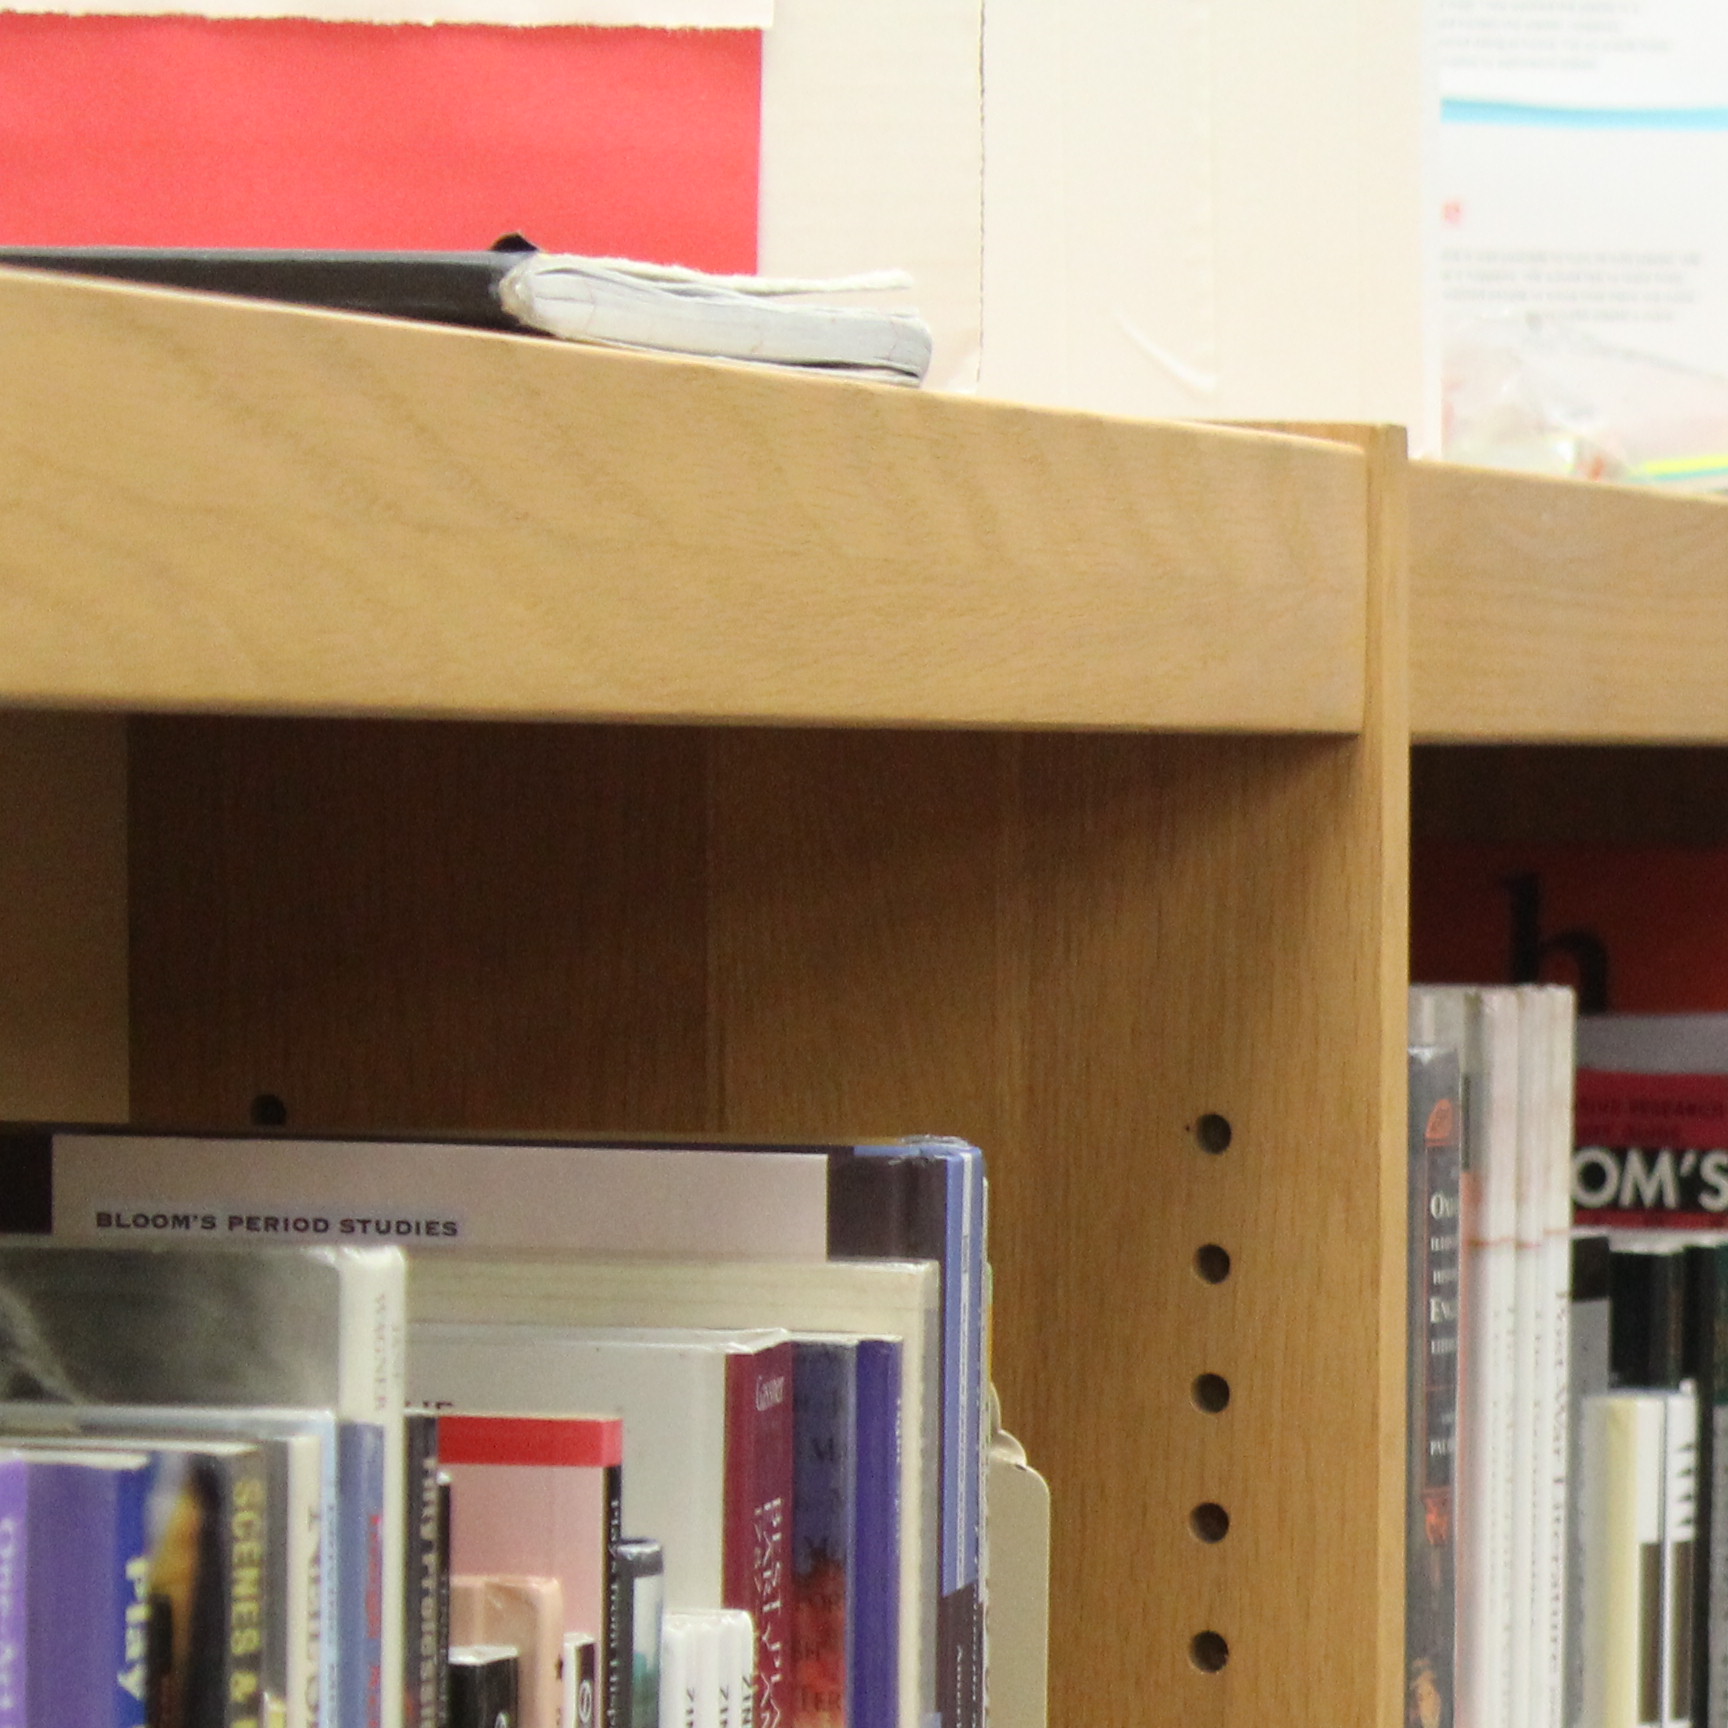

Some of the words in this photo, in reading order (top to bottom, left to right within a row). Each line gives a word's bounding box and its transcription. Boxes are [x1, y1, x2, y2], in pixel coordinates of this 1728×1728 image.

[96, 1211, 217, 1231] BLOOM'S
[228, 1214, 329, 1235] PERIOD
[339, 1217, 459, 1238] STUDIES
[231, 1479, 269, 1657] SCENES
[768, 1497, 784, 1614] BEST
[116, 1557, 152, 1702] Play
[228, 1671, 264, 1702] &
